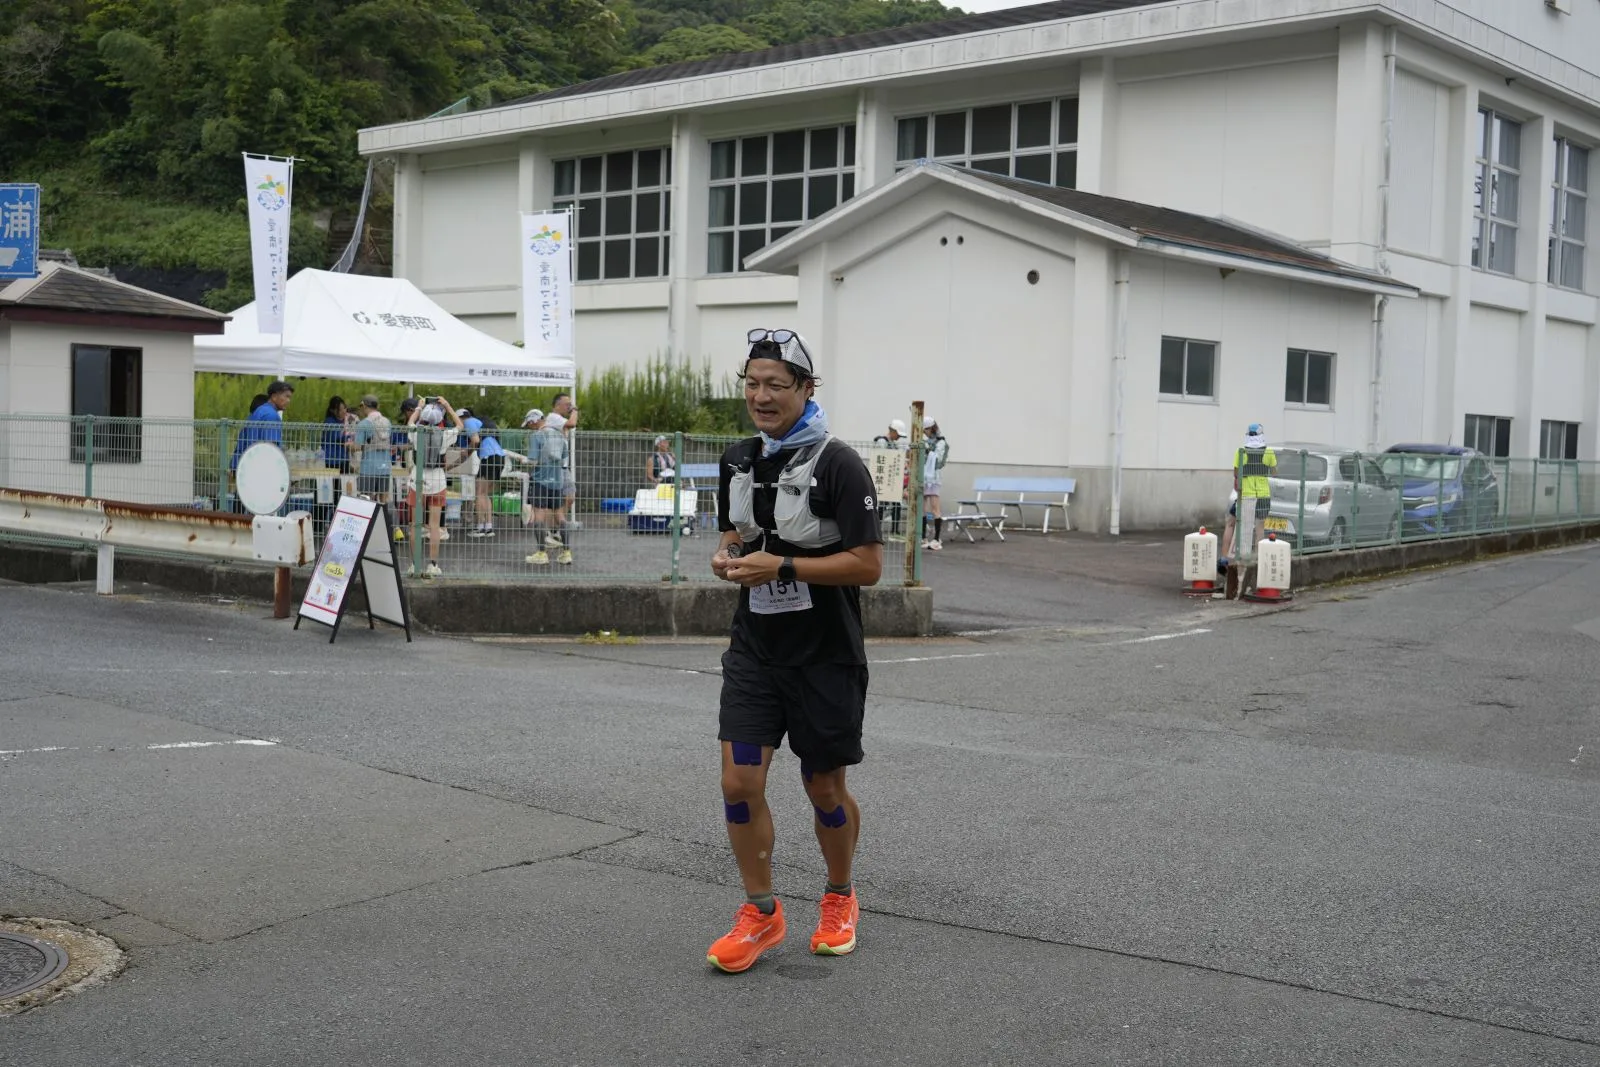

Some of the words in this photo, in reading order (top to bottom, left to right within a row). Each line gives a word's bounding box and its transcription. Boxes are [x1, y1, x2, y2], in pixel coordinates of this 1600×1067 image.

[0, 201, 32, 238] 浦
[378, 313, 437, 331] 愛南町
[875, 455, 886, 494] 駐車禁止
[1191, 542, 1199, 574] 駐車禁止
[766, 580, 799, 596] 151
